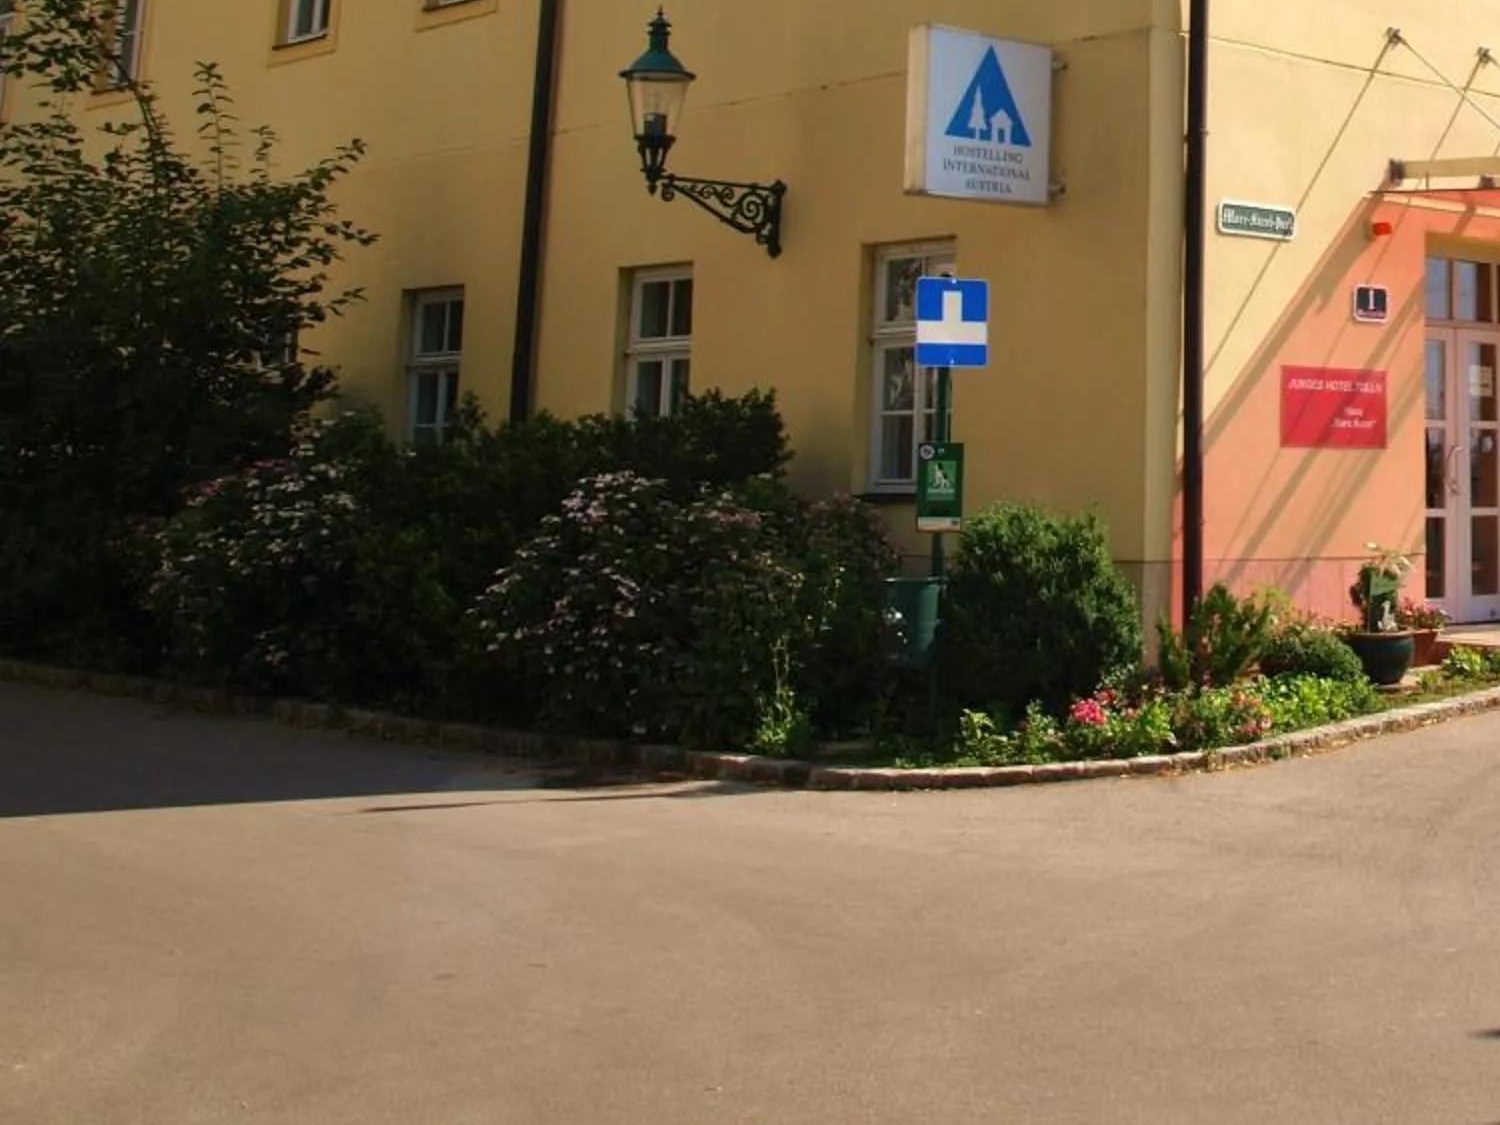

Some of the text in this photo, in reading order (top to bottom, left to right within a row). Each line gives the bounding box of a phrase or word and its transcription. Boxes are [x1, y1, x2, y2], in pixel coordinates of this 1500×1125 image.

[953, 146, 1023, 164] HOSTELLING
[943, 158, 1030, 181] INTERNATIONAL
[965, 178, 1012, 194] AUSTRIA
[1367, 290, 1377, 310] 1
